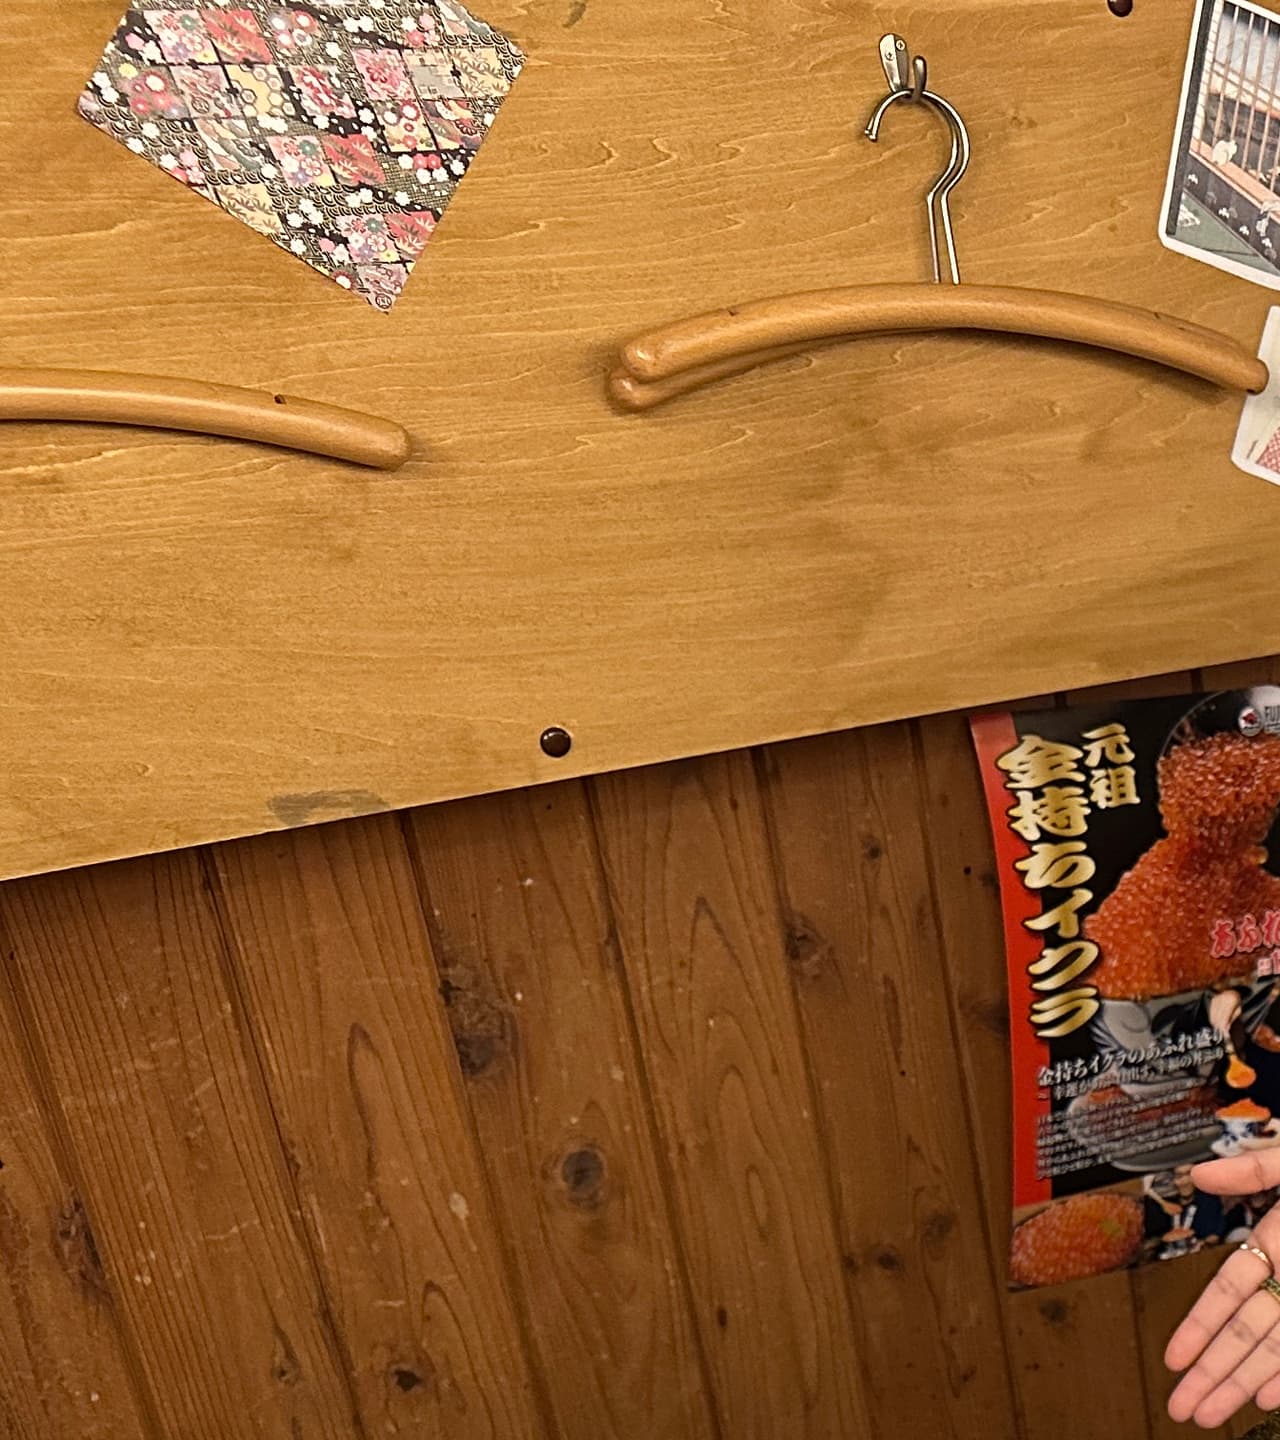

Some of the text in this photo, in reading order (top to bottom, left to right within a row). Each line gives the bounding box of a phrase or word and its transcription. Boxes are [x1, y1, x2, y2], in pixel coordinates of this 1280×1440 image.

[1082, 722, 1141, 809] 元祖
[997, 734, 1101, 1037] 金持ちイクラ
